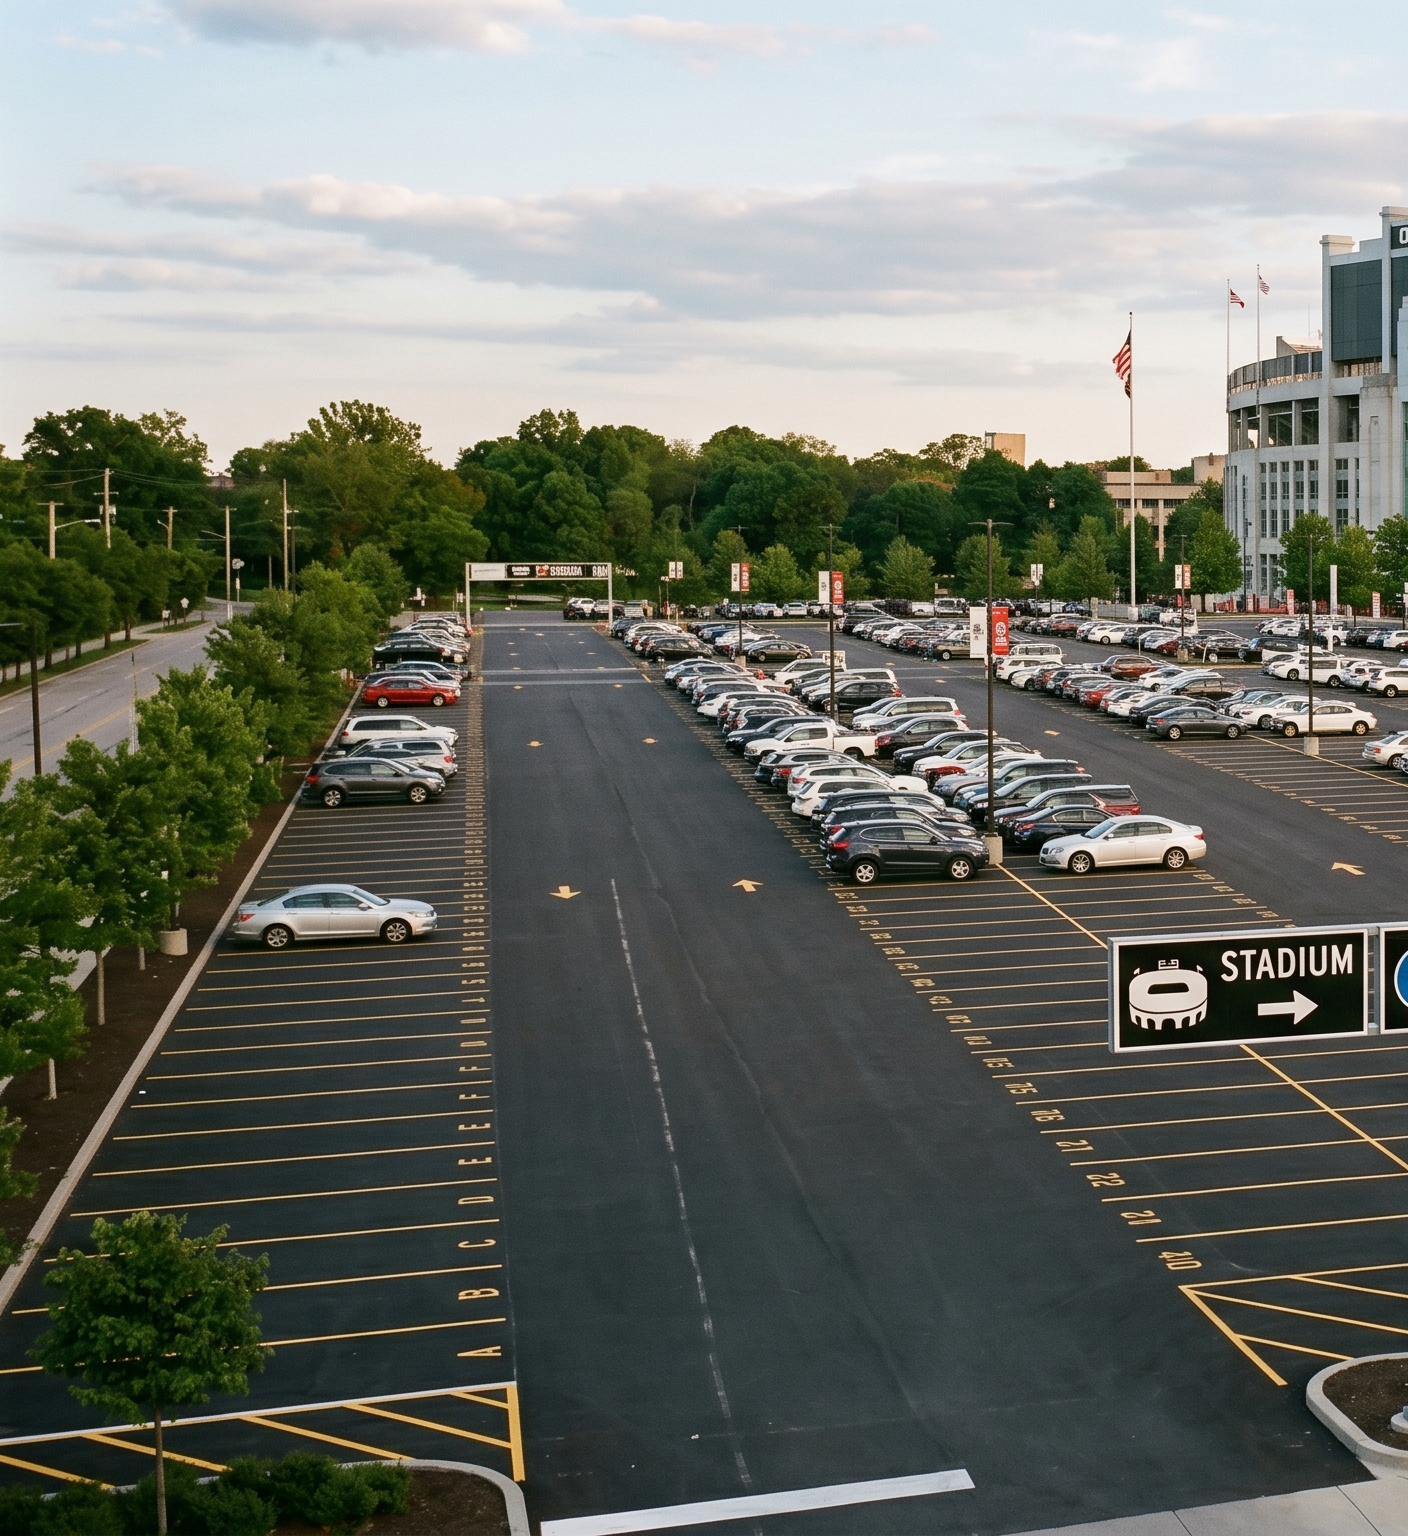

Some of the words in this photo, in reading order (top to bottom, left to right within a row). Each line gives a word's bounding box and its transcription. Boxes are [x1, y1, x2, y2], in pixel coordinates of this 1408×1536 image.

[1220, 943, 1353, 982] STADIUM
[458, 1122, 491, 1131] E
[458, 1156, 493, 1166] E
[458, 1195, 495, 1205] D
[458, 1238, 497, 1248] C
[458, 1287, 500, 1301] B
[457, 1345, 502, 1357] A
